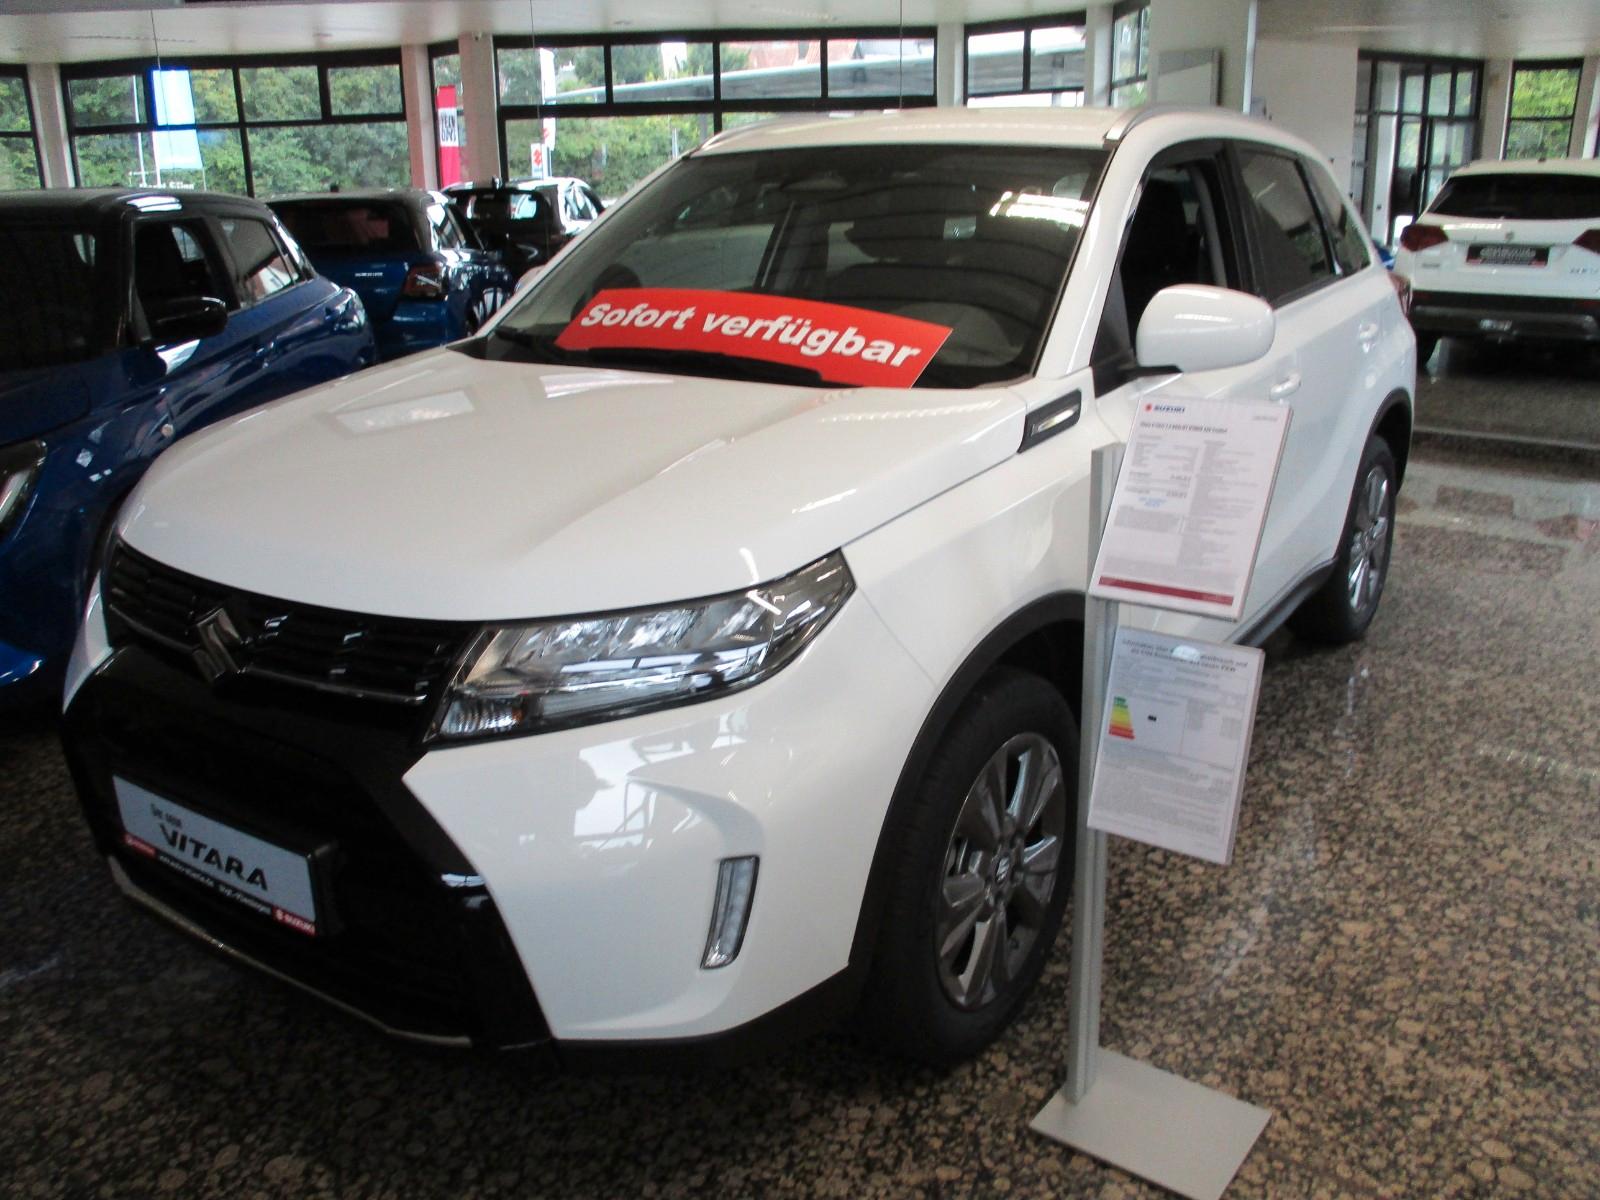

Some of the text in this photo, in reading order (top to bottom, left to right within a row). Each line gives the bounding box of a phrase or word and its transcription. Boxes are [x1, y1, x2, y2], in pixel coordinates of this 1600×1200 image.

[580, 302, 921, 368] Sofort verfügbar
[159, 823, 268, 890] VITARA
